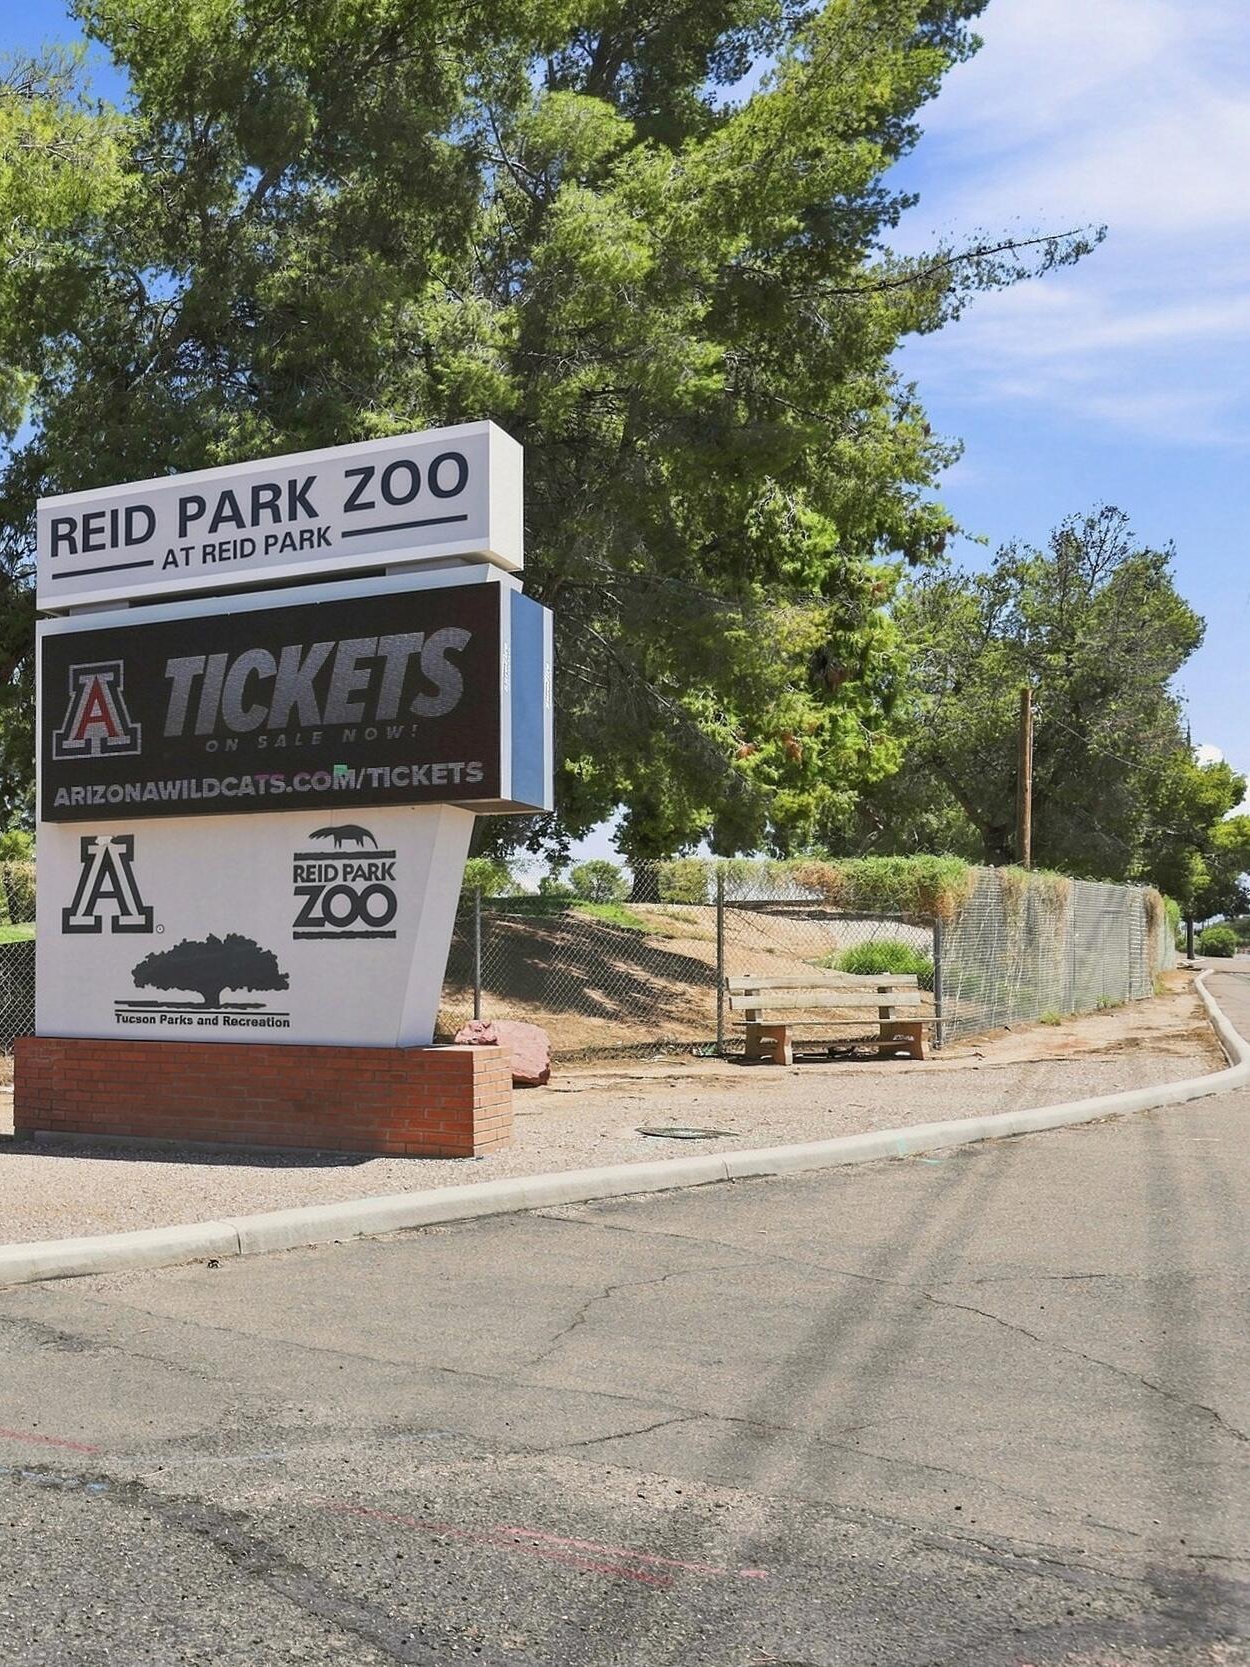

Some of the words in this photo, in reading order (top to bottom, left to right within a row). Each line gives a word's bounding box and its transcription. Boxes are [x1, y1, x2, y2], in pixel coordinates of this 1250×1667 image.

[50, 505, 156, 558] REID
[178, 475, 320, 538] PARK
[343, 451, 469, 514] ZOO
[161, 545, 193, 570] AT
[202, 538, 257, 565] REID
[264, 526, 333, 556] PARK
[163, 626, 472, 737] TICKETS
[52, 660, 141, 760] A
[205, 737, 239, 753] ON
[257, 730, 323, 750] SALE
[342, 723, 419, 743] NOW!
[53, 760, 484, 807] ARIZONAWILDCATS.COM/TICKETS
[62, 834, 154, 934] A
[293, 863, 338, 883] REID
[342, 861, 397, 882] PARK
[292, 883, 398, 928] ZOO
[114, 1013, 157, 1025] Tucson
[160, 1014, 193, 1025] Parks
[196, 1015, 219, 1027] and
[222, 1016, 291, 1028] Recreation
